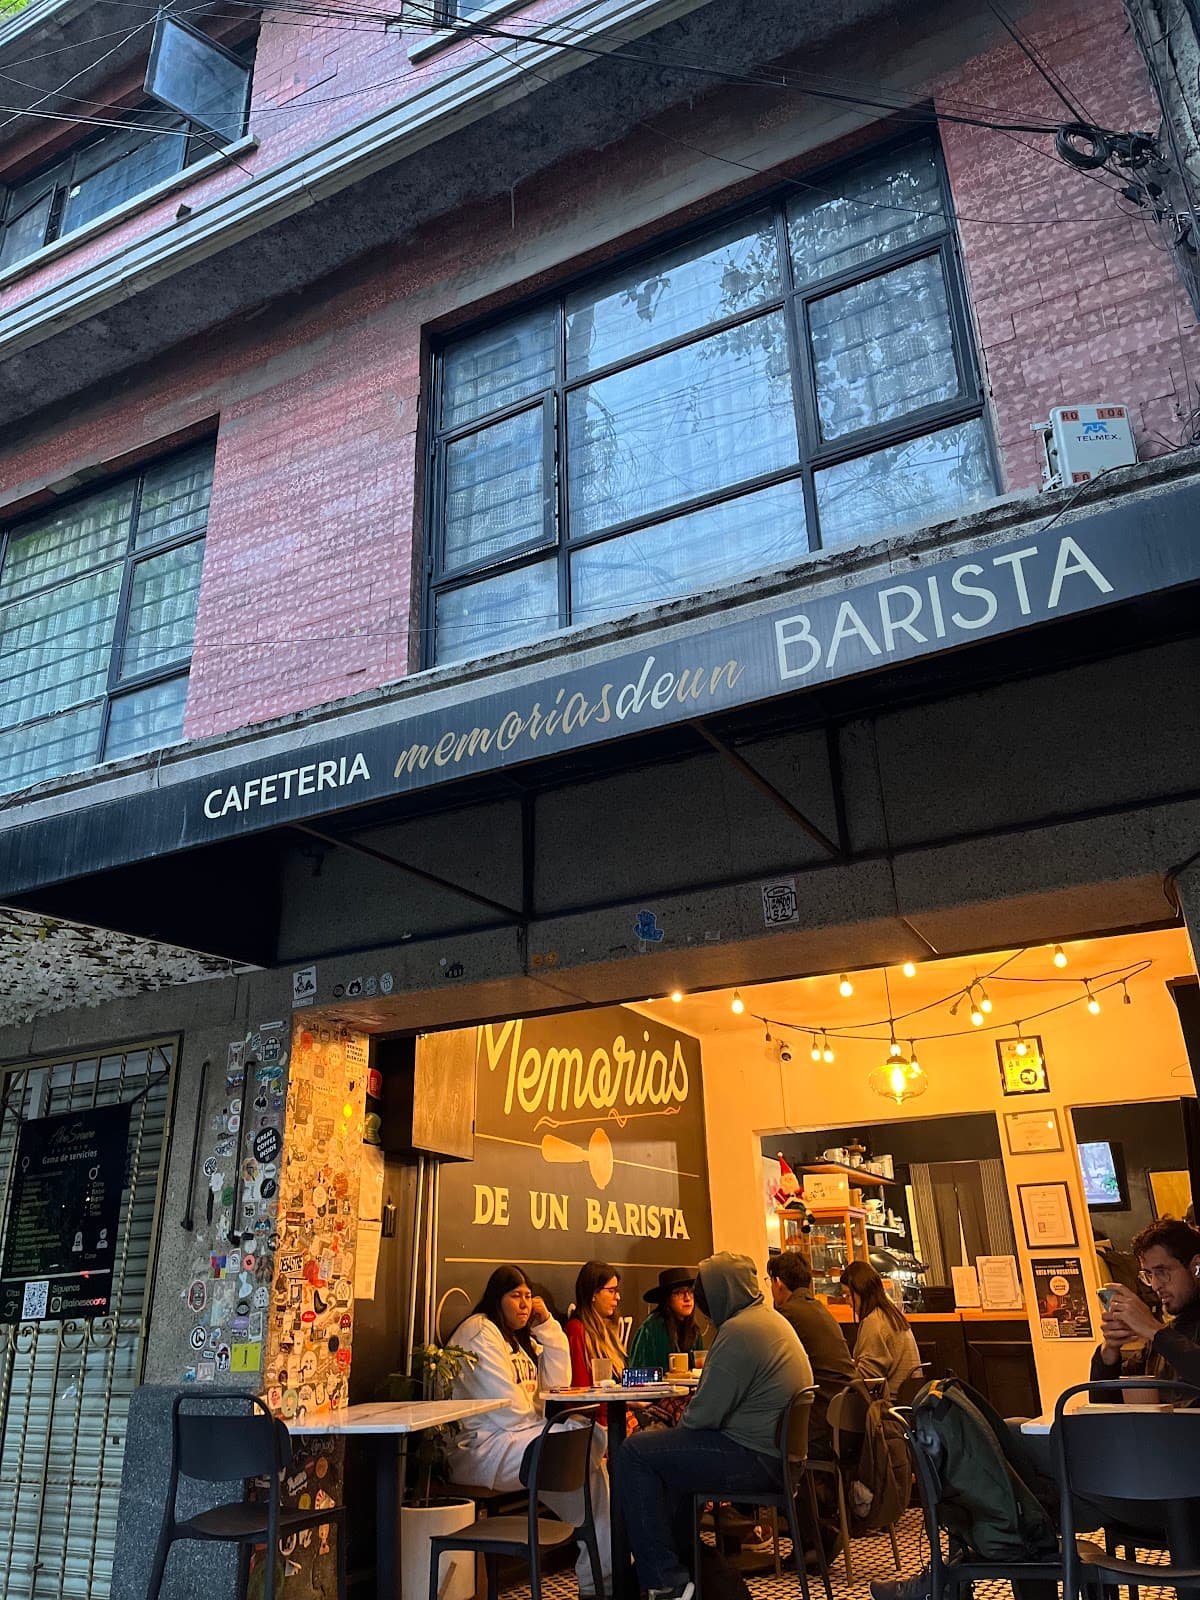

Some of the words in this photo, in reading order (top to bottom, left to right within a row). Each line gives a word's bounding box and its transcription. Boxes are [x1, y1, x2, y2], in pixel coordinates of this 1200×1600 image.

[1076, 433, 1119, 442] TELMEX
[203, 752, 371, 819] CAFETERIA
[774, 536, 1114, 681] BARISTA
[476, 1018, 689, 1116] Memorias
[257, 1129, 273, 1144] GREAT
[257, 1135, 276, 1152] COFFEE
[260, 1143, 277, 1158] INSIDE
[472, 1184, 510, 1226] DE
[529, 1190, 569, 1231] UN
[585, 1198, 691, 1240] BARISTA
